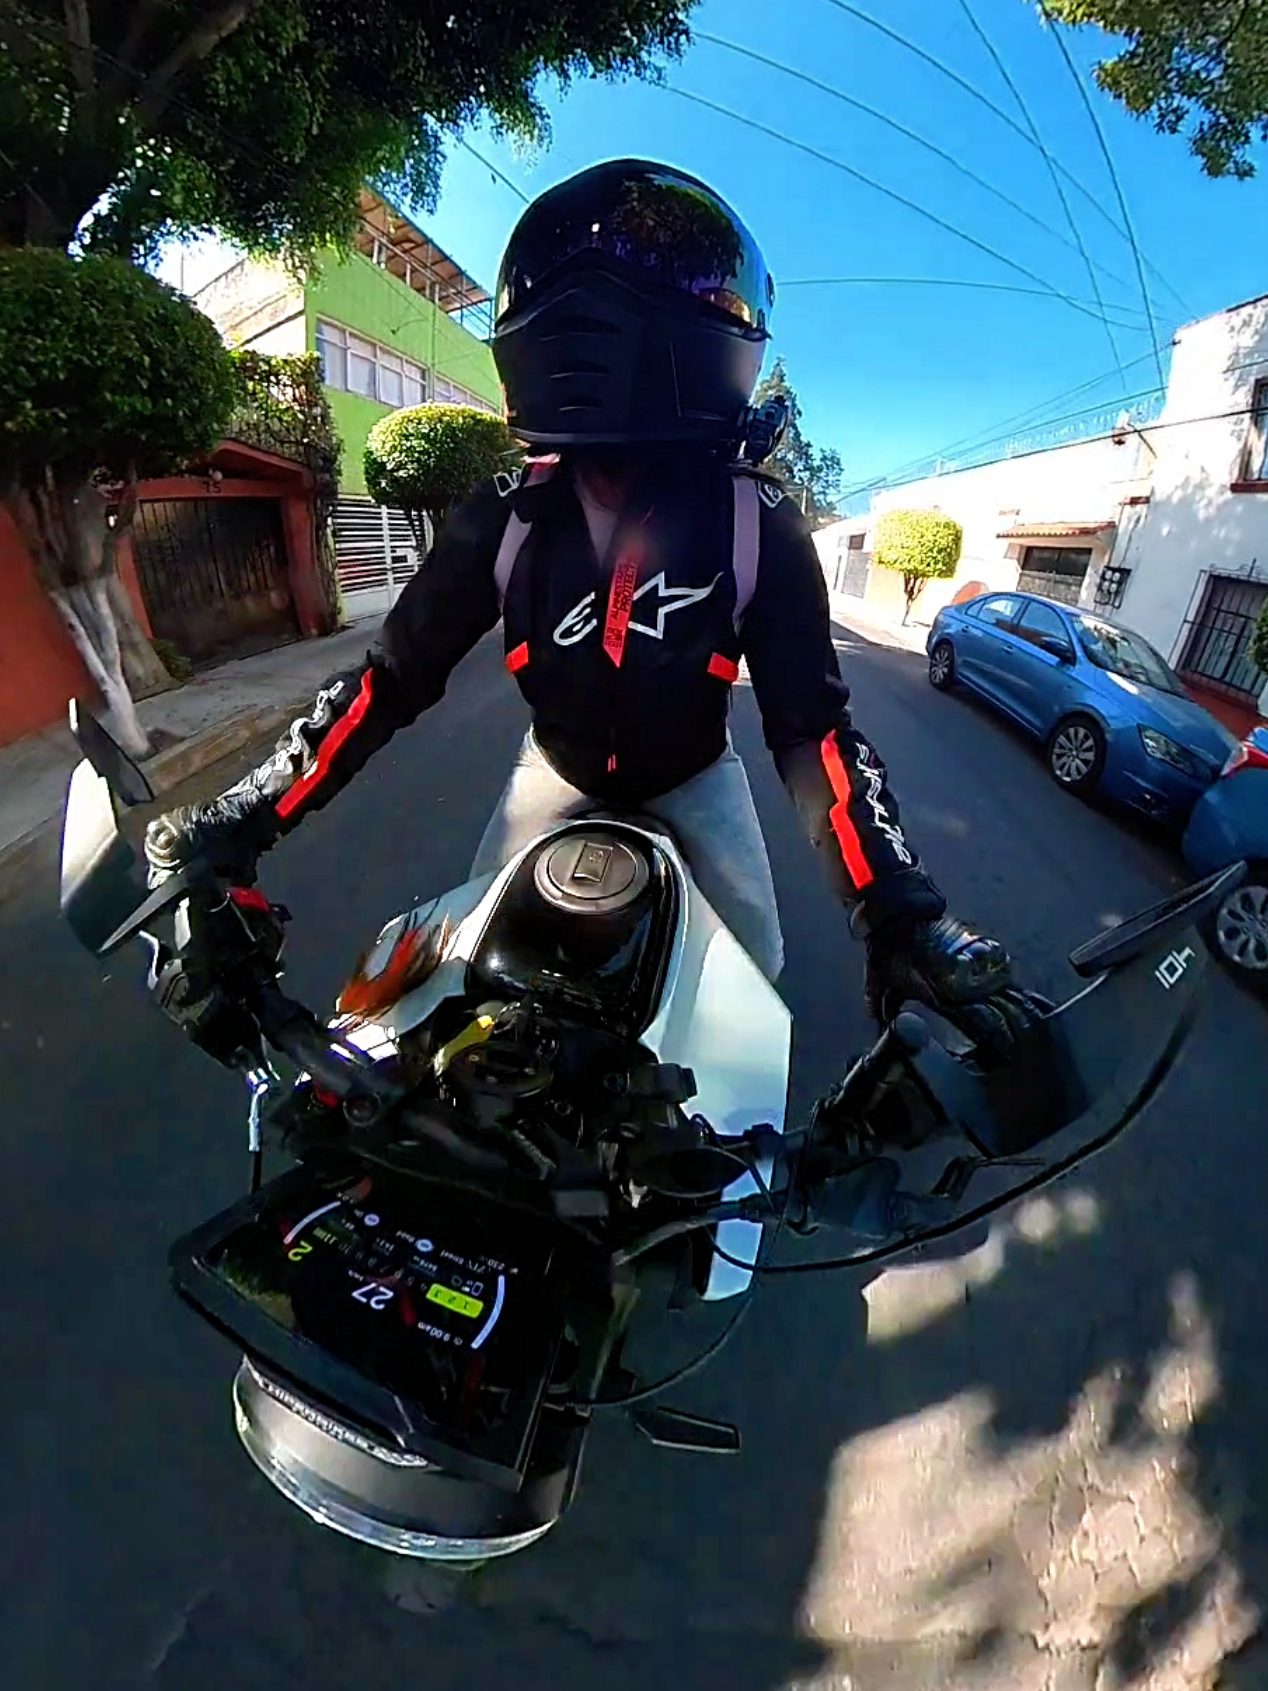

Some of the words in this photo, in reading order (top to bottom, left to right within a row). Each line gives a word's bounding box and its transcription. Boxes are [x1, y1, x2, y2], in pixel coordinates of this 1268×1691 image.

[203, 480, 221, 493] 75
[288, 1240, 313, 1261] 2
[351, 1282, 394, 1310] 27
